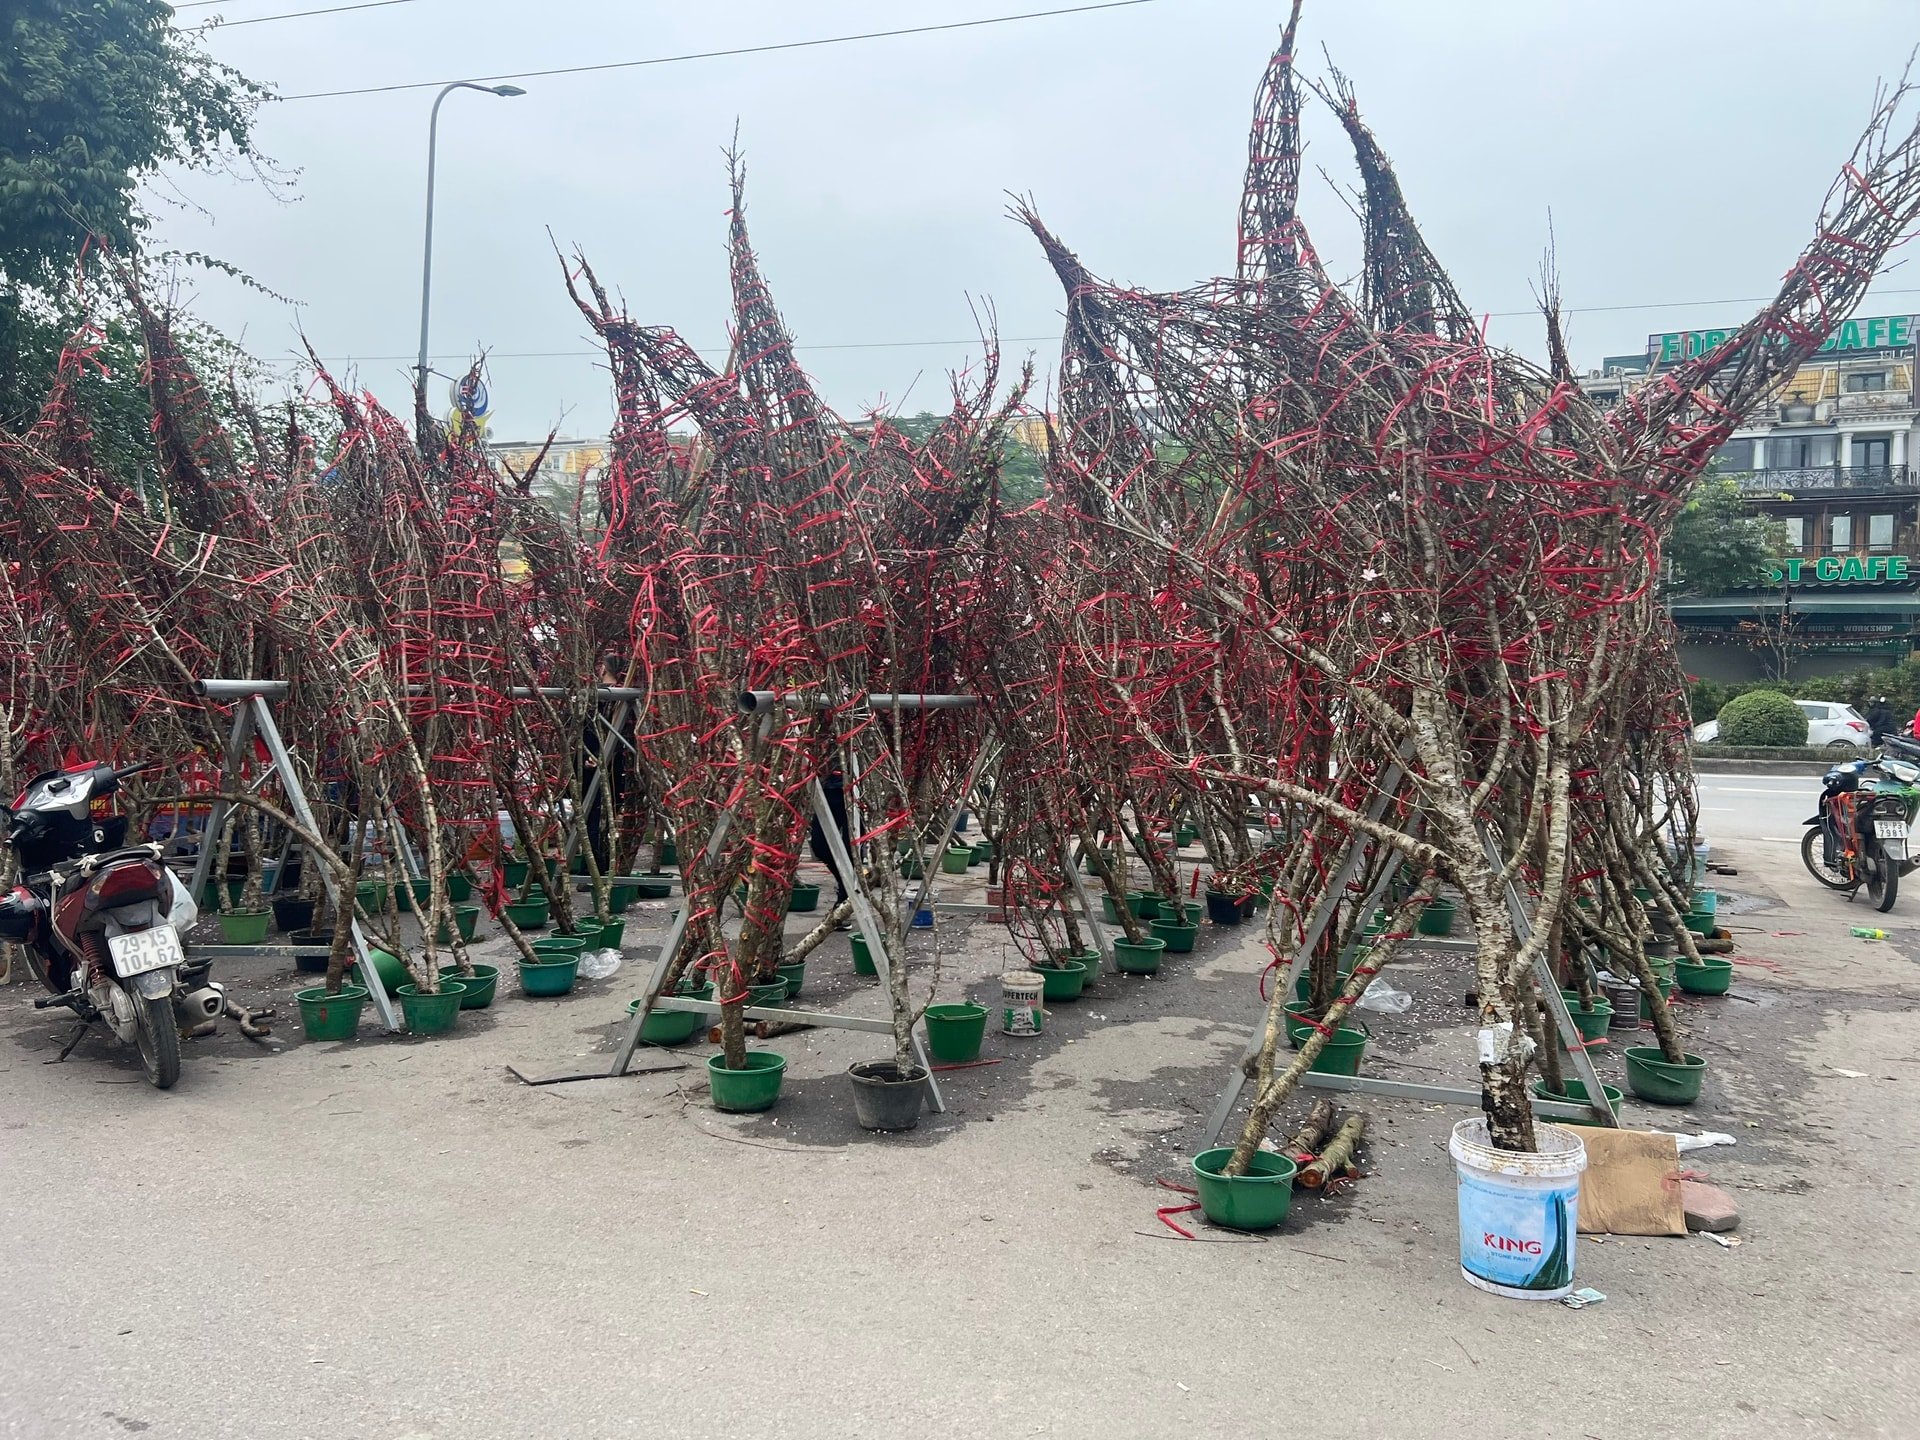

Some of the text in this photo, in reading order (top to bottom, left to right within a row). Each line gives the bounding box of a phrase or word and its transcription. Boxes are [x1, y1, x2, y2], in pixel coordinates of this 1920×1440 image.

[1816, 556, 1909, 581] CAFE
[120, 929, 168, 955] 29-X5
[1484, 1231, 1542, 1255] KING
